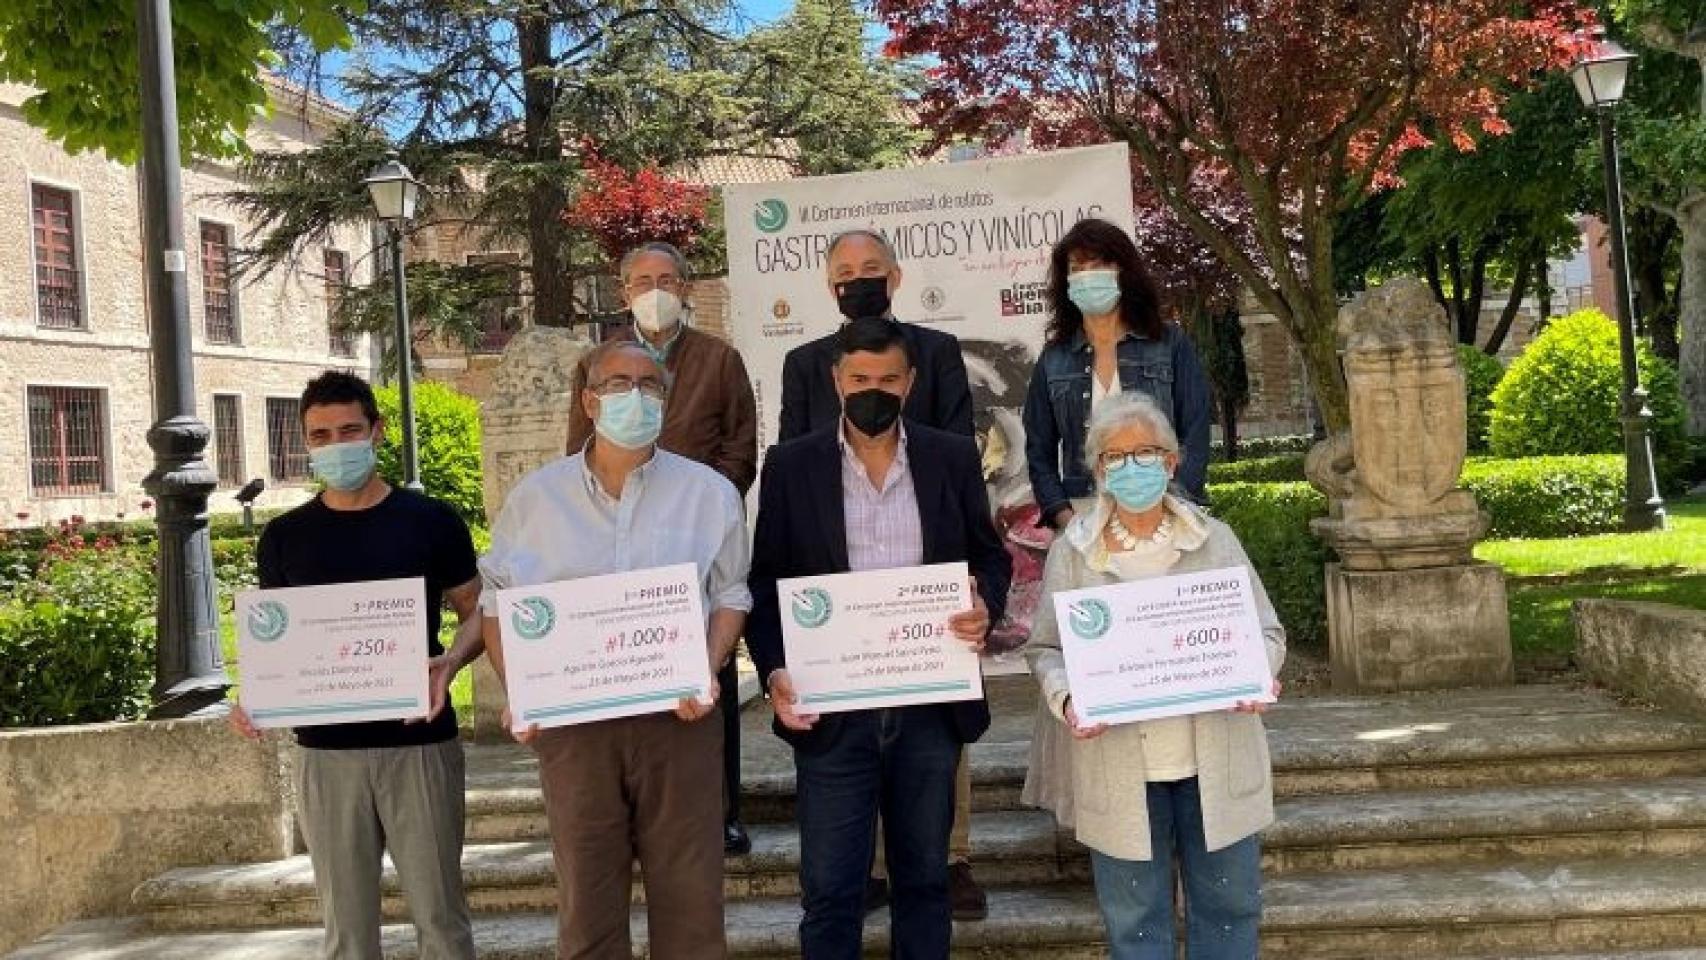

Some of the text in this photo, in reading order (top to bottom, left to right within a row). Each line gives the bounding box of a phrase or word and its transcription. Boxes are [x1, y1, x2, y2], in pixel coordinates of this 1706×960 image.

[812, 203, 865, 221] Certamen
[938, 191, 953, 209] de
[961, 218, 976, 254] Y
[640, 583, 689, 599] PREMIO
[912, 582, 960, 597] PREMIO
[1191, 579, 1240, 593] PREMIO
[367, 598, 416, 613] PREMIO
